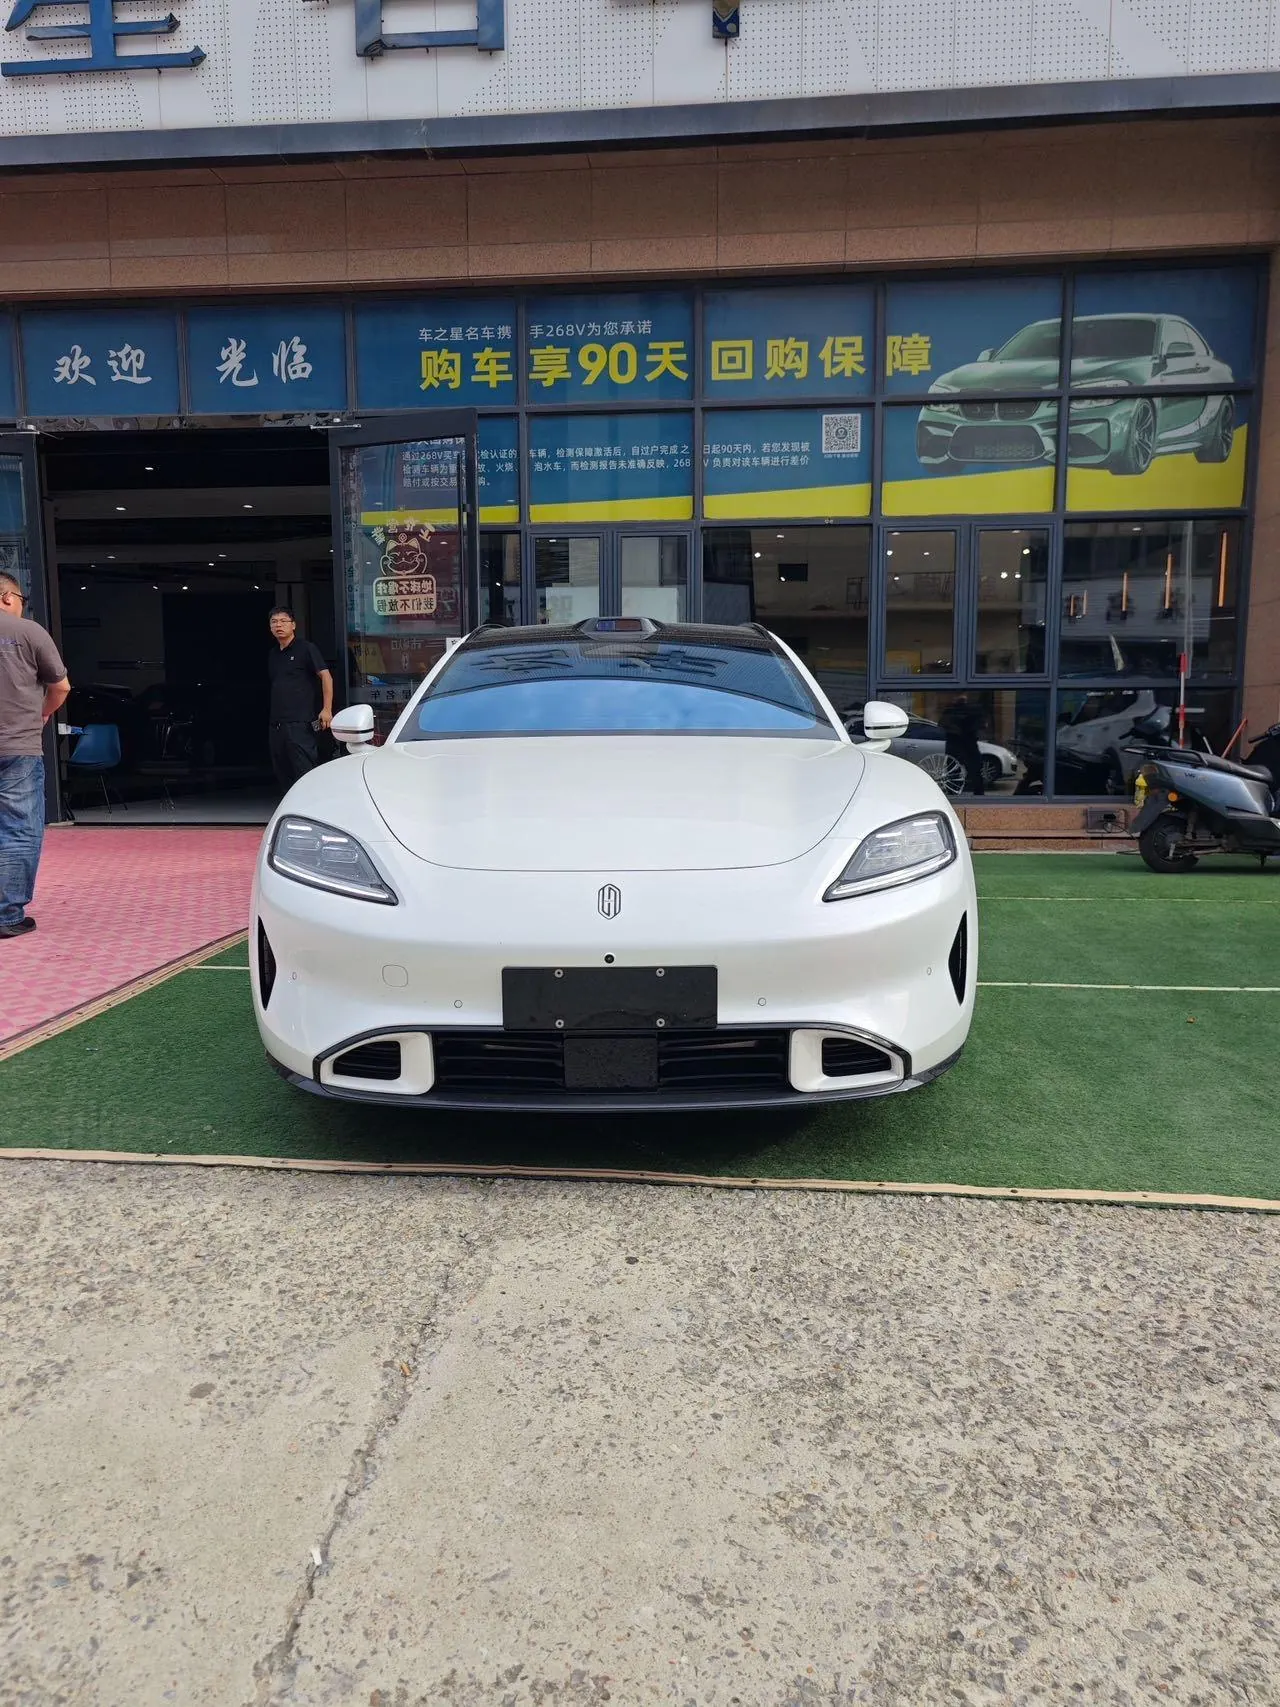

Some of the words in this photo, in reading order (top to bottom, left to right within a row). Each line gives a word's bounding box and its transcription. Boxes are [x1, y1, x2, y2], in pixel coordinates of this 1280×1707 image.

[418, 320, 652, 342] 车之星名车携手268V为您承诺
[53, 336, 312, 386] 欢迎光临
[419, 333, 931, 391] 购车享90天回购保障
